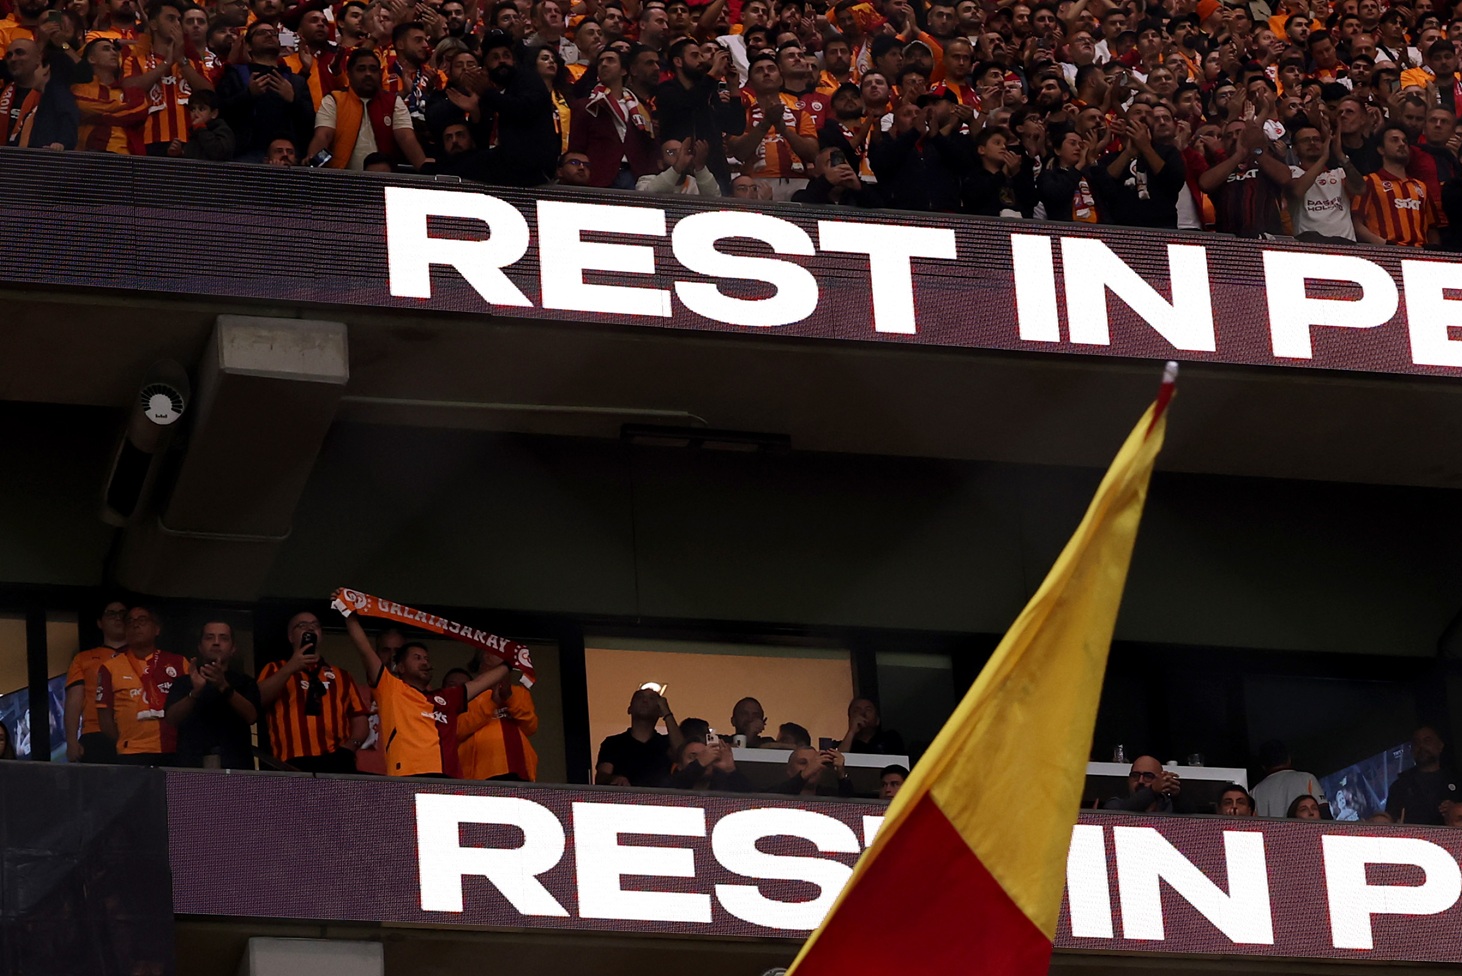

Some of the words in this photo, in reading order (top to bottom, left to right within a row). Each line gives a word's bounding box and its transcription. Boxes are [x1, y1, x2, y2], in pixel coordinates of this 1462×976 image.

[385, 187, 957, 335] REST
[1011, 234, 1216, 352] IN
[415, 793, 886, 931] RES
[1066, 825, 1275, 945] IN
